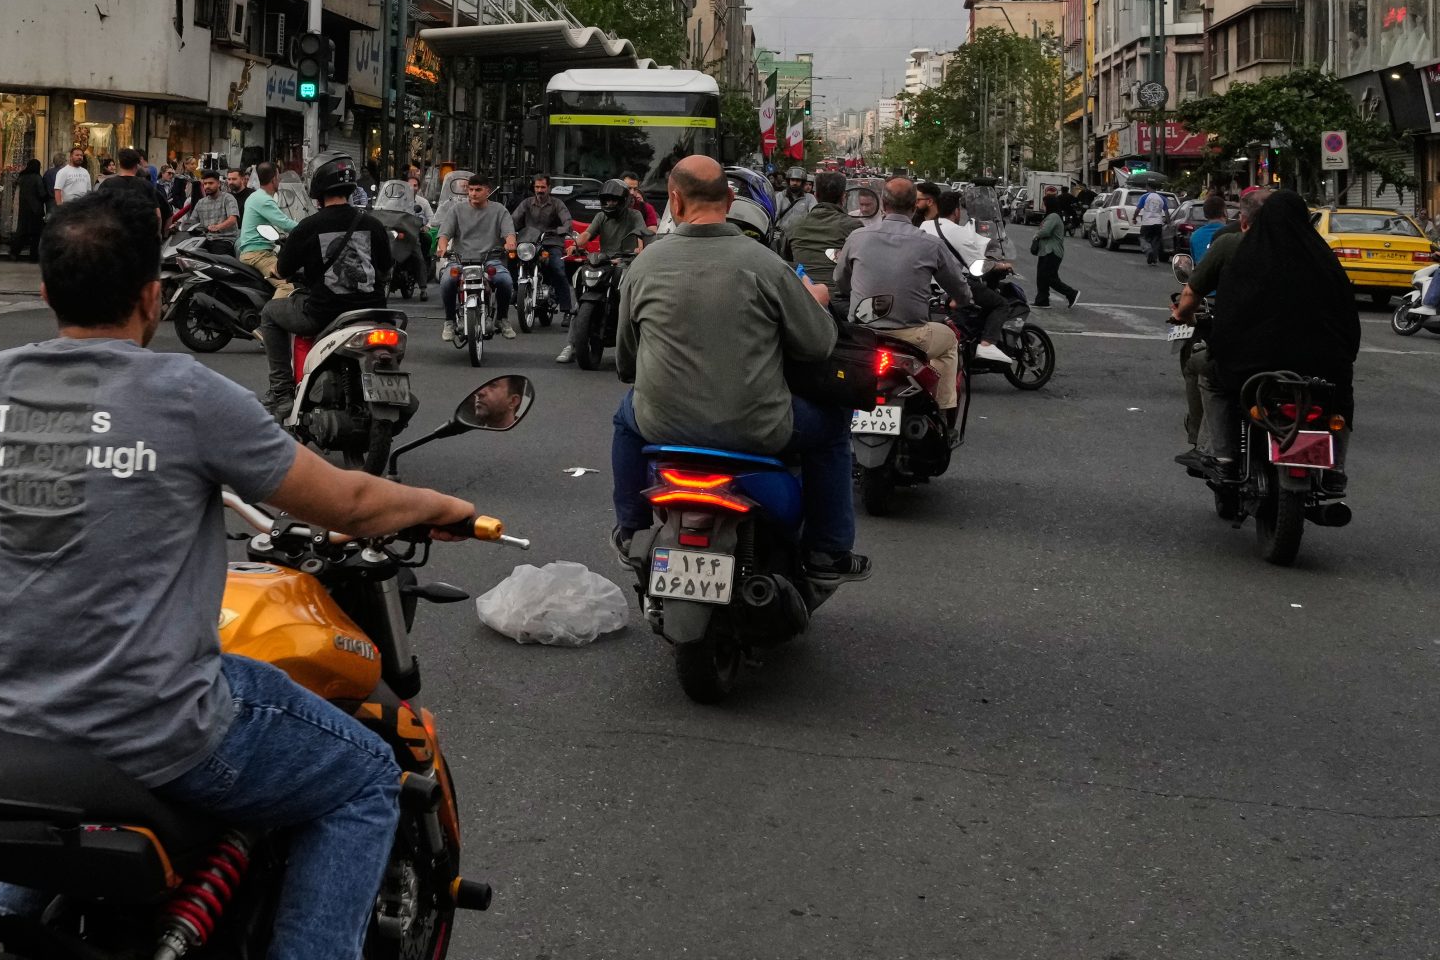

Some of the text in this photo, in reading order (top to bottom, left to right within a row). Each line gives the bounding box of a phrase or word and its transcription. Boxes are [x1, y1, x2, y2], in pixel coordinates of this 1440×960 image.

[1140, 126, 1179, 139] TOWEL
[850, 419, 897, 432] ۶۶۲۵۶
[33, 440, 157, 479] enough
[6, 475, 80, 506] time.
[682, 555, 721, 576] ۱۴۴
[655, 574, 727, 599] ۵۶۵۷۳
